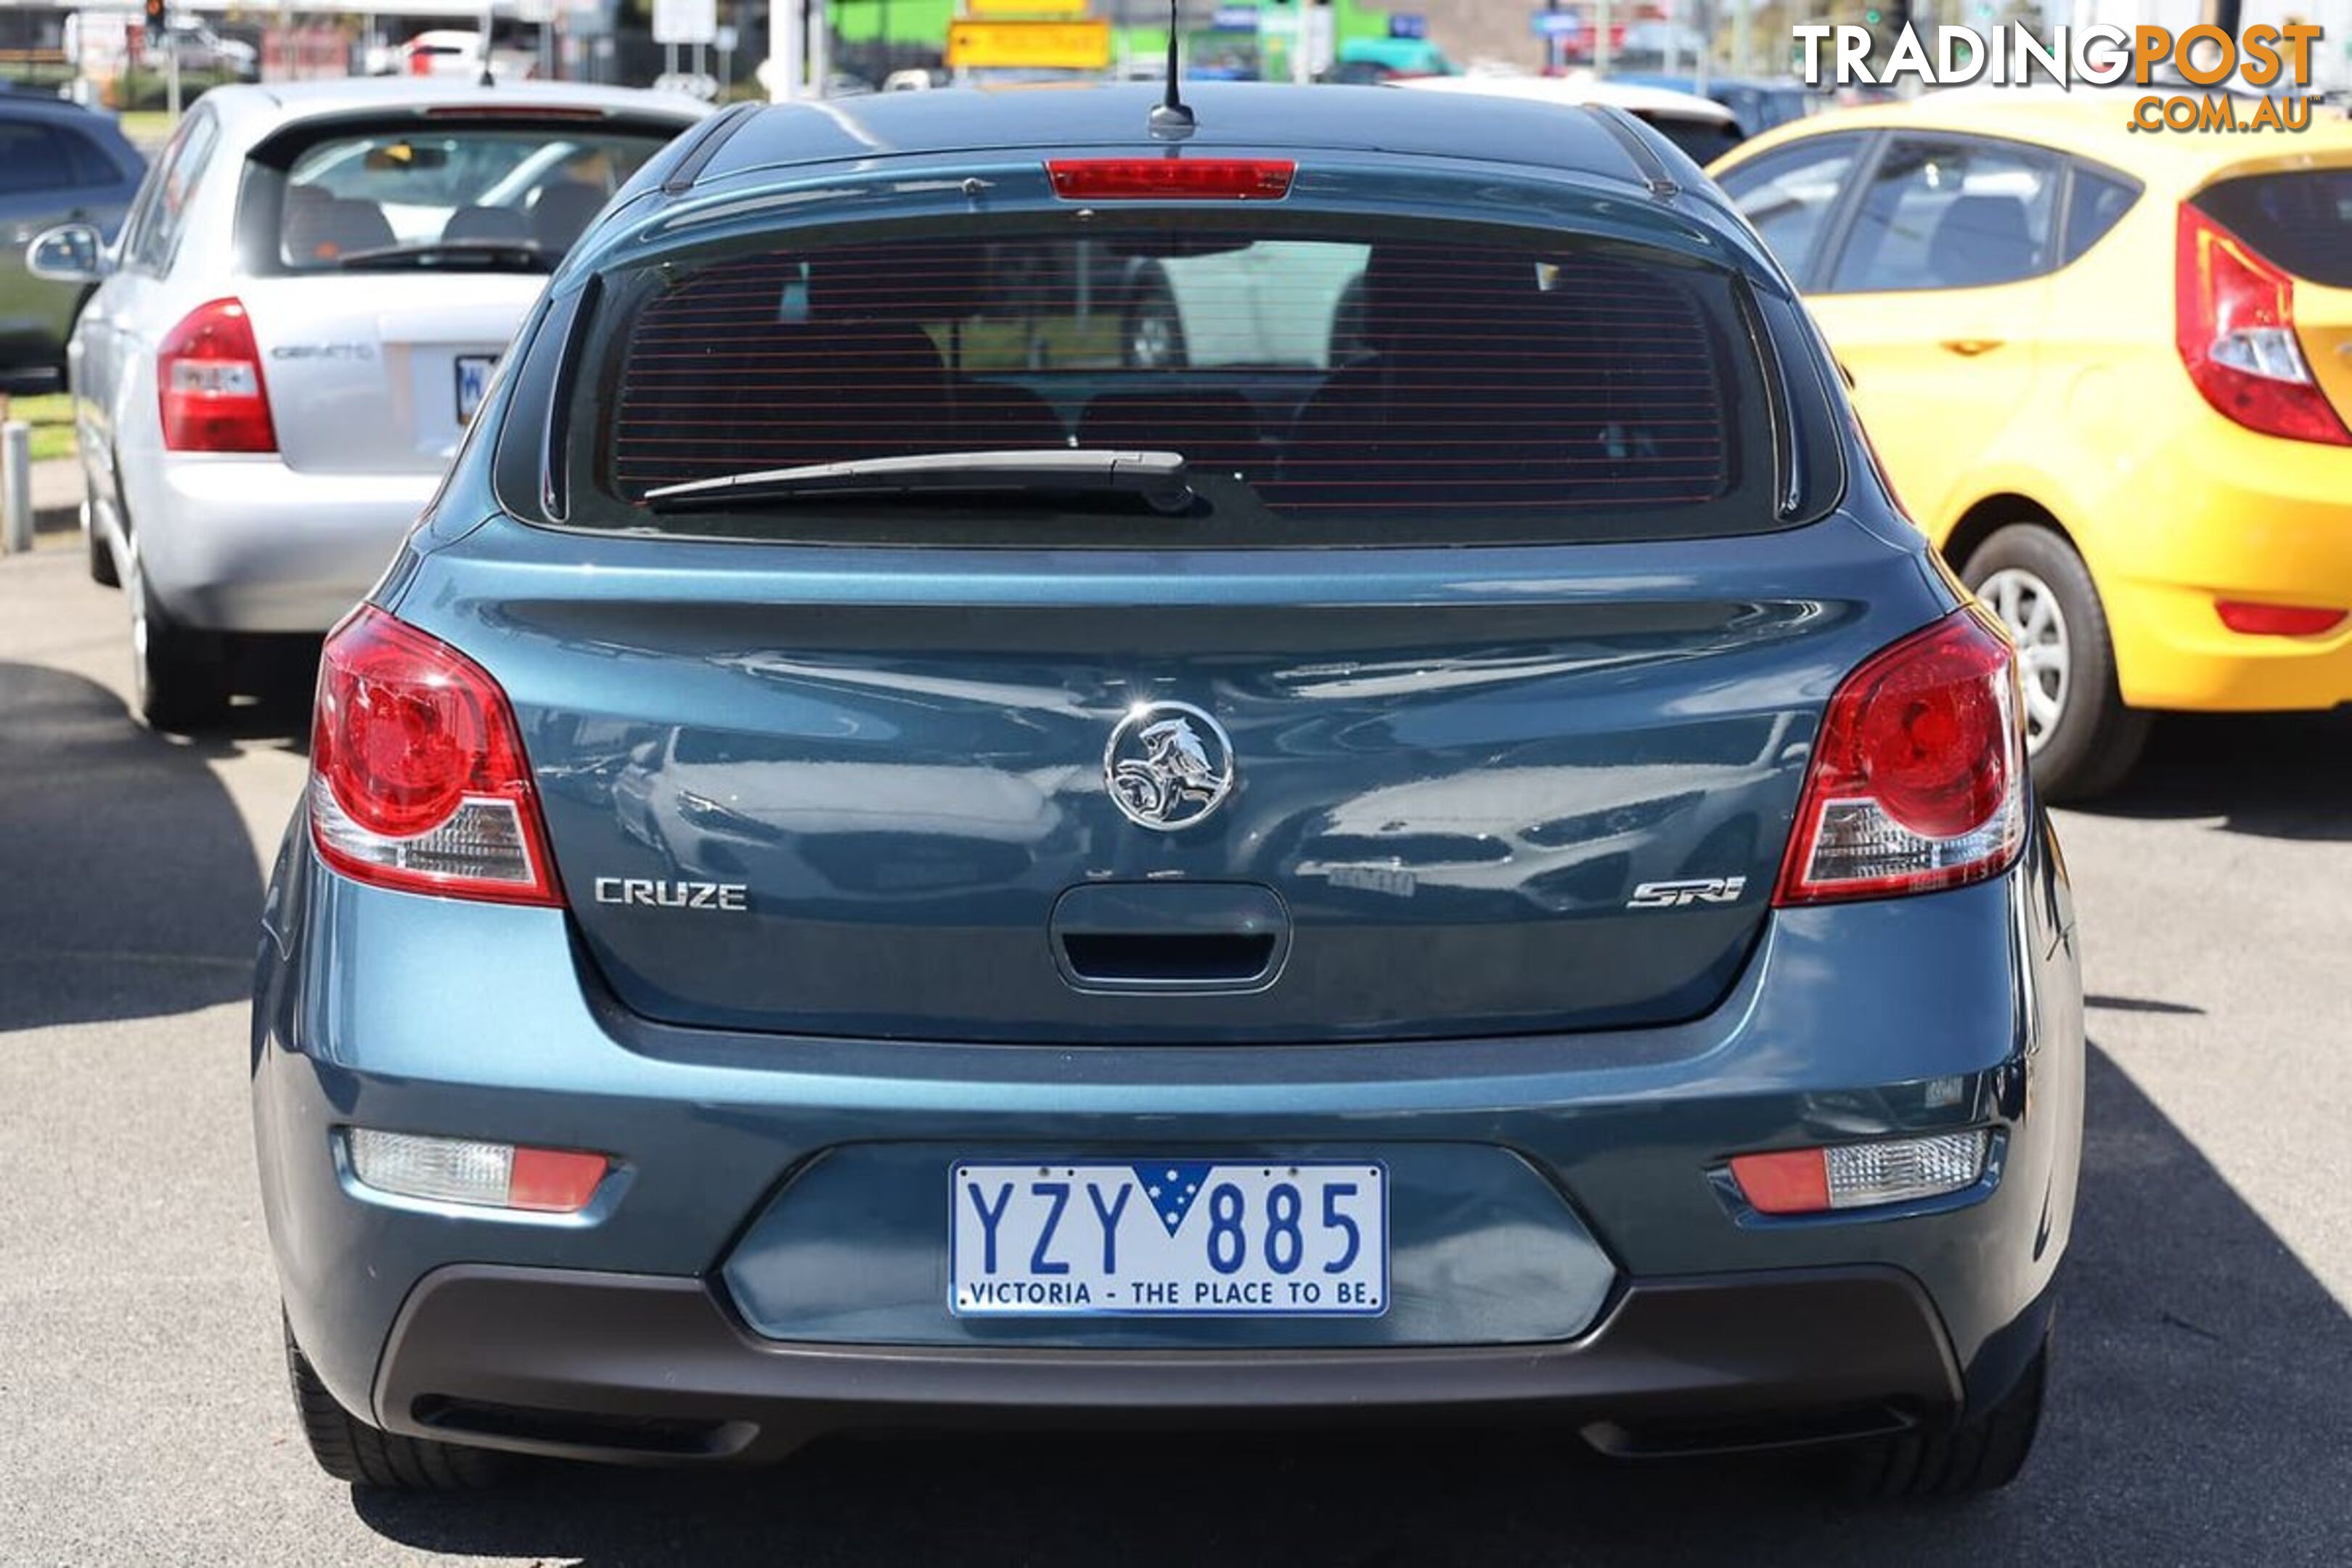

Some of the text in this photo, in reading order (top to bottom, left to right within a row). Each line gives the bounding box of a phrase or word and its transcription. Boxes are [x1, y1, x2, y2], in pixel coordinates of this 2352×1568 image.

[595, 877, 748, 911] CRUZE
[968, 1183, 1360, 1275] YZY 885
[970, 1282, 1092, 1304] VICTORIA
[1131, 1282, 1179, 1304] THE
[1195, 1282, 1273, 1304] PLACE
[1288, 1282, 1321, 1304] TO
[1337, 1282, 1366, 1304] BE
